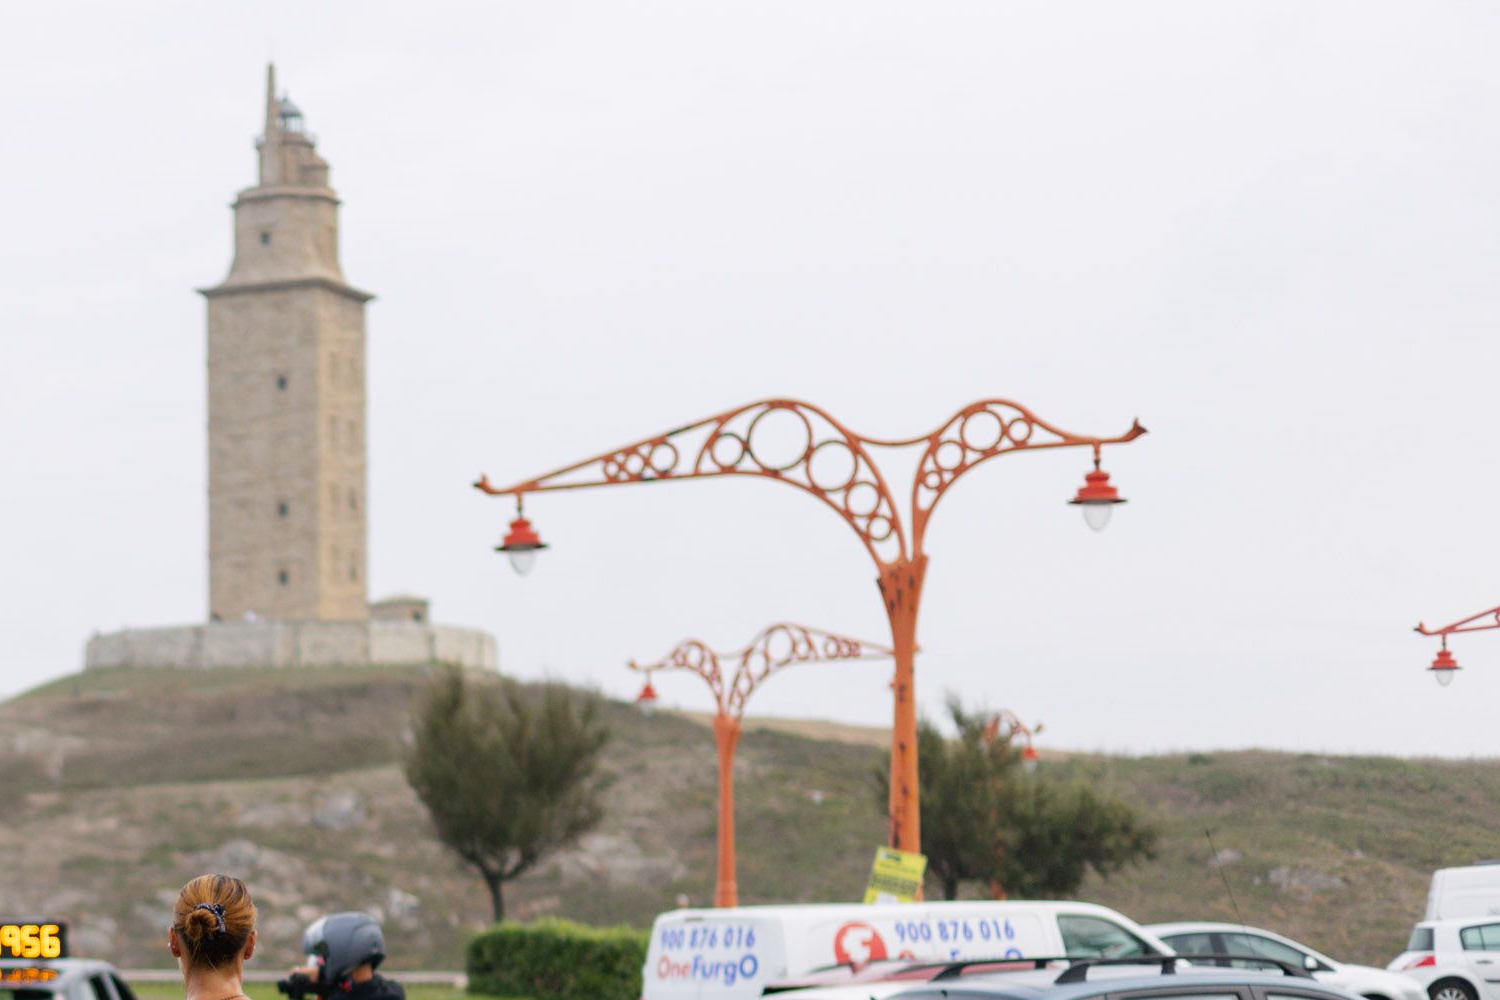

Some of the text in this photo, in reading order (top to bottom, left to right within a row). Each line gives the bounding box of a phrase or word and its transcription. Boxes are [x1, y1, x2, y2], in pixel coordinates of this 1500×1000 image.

[723, 924, 756, 949] 016
[894, 919, 1015, 942] 900 876 016
